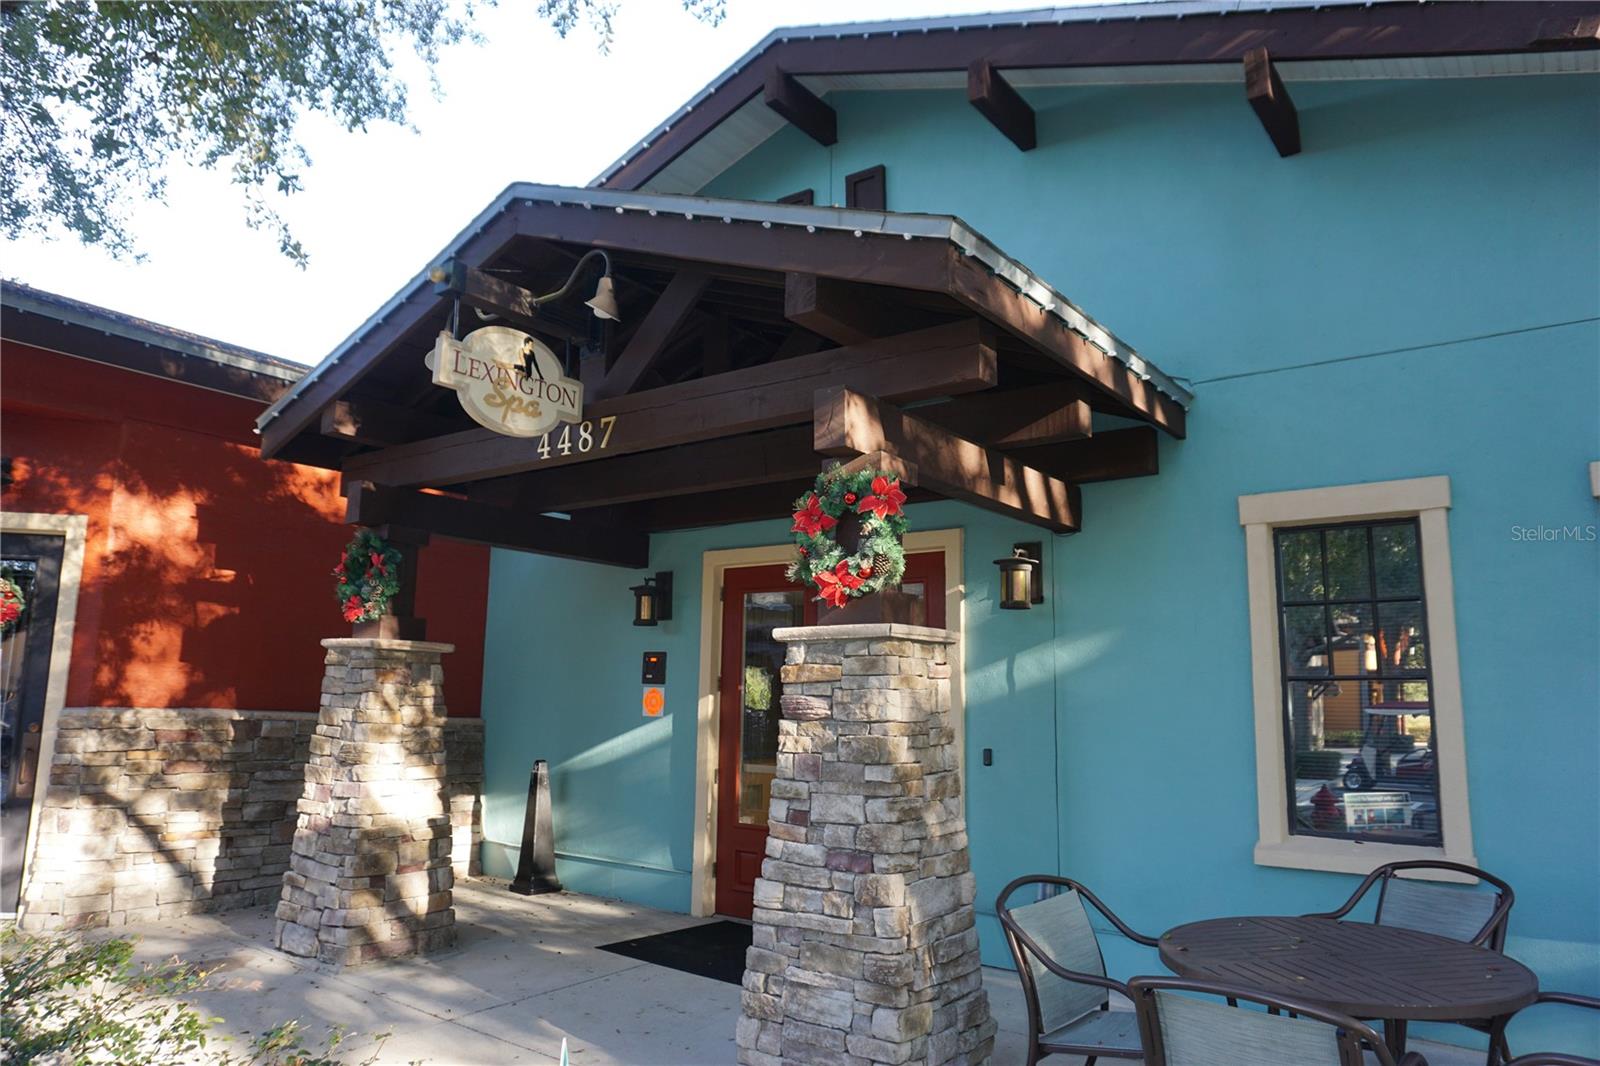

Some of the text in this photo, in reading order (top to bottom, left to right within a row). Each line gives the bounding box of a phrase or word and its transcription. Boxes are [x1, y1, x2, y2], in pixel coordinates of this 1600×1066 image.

[453, 349, 577, 410] LEXINGTON
[483, 376, 542, 423] Spa
[536, 416, 616, 460] 4487
